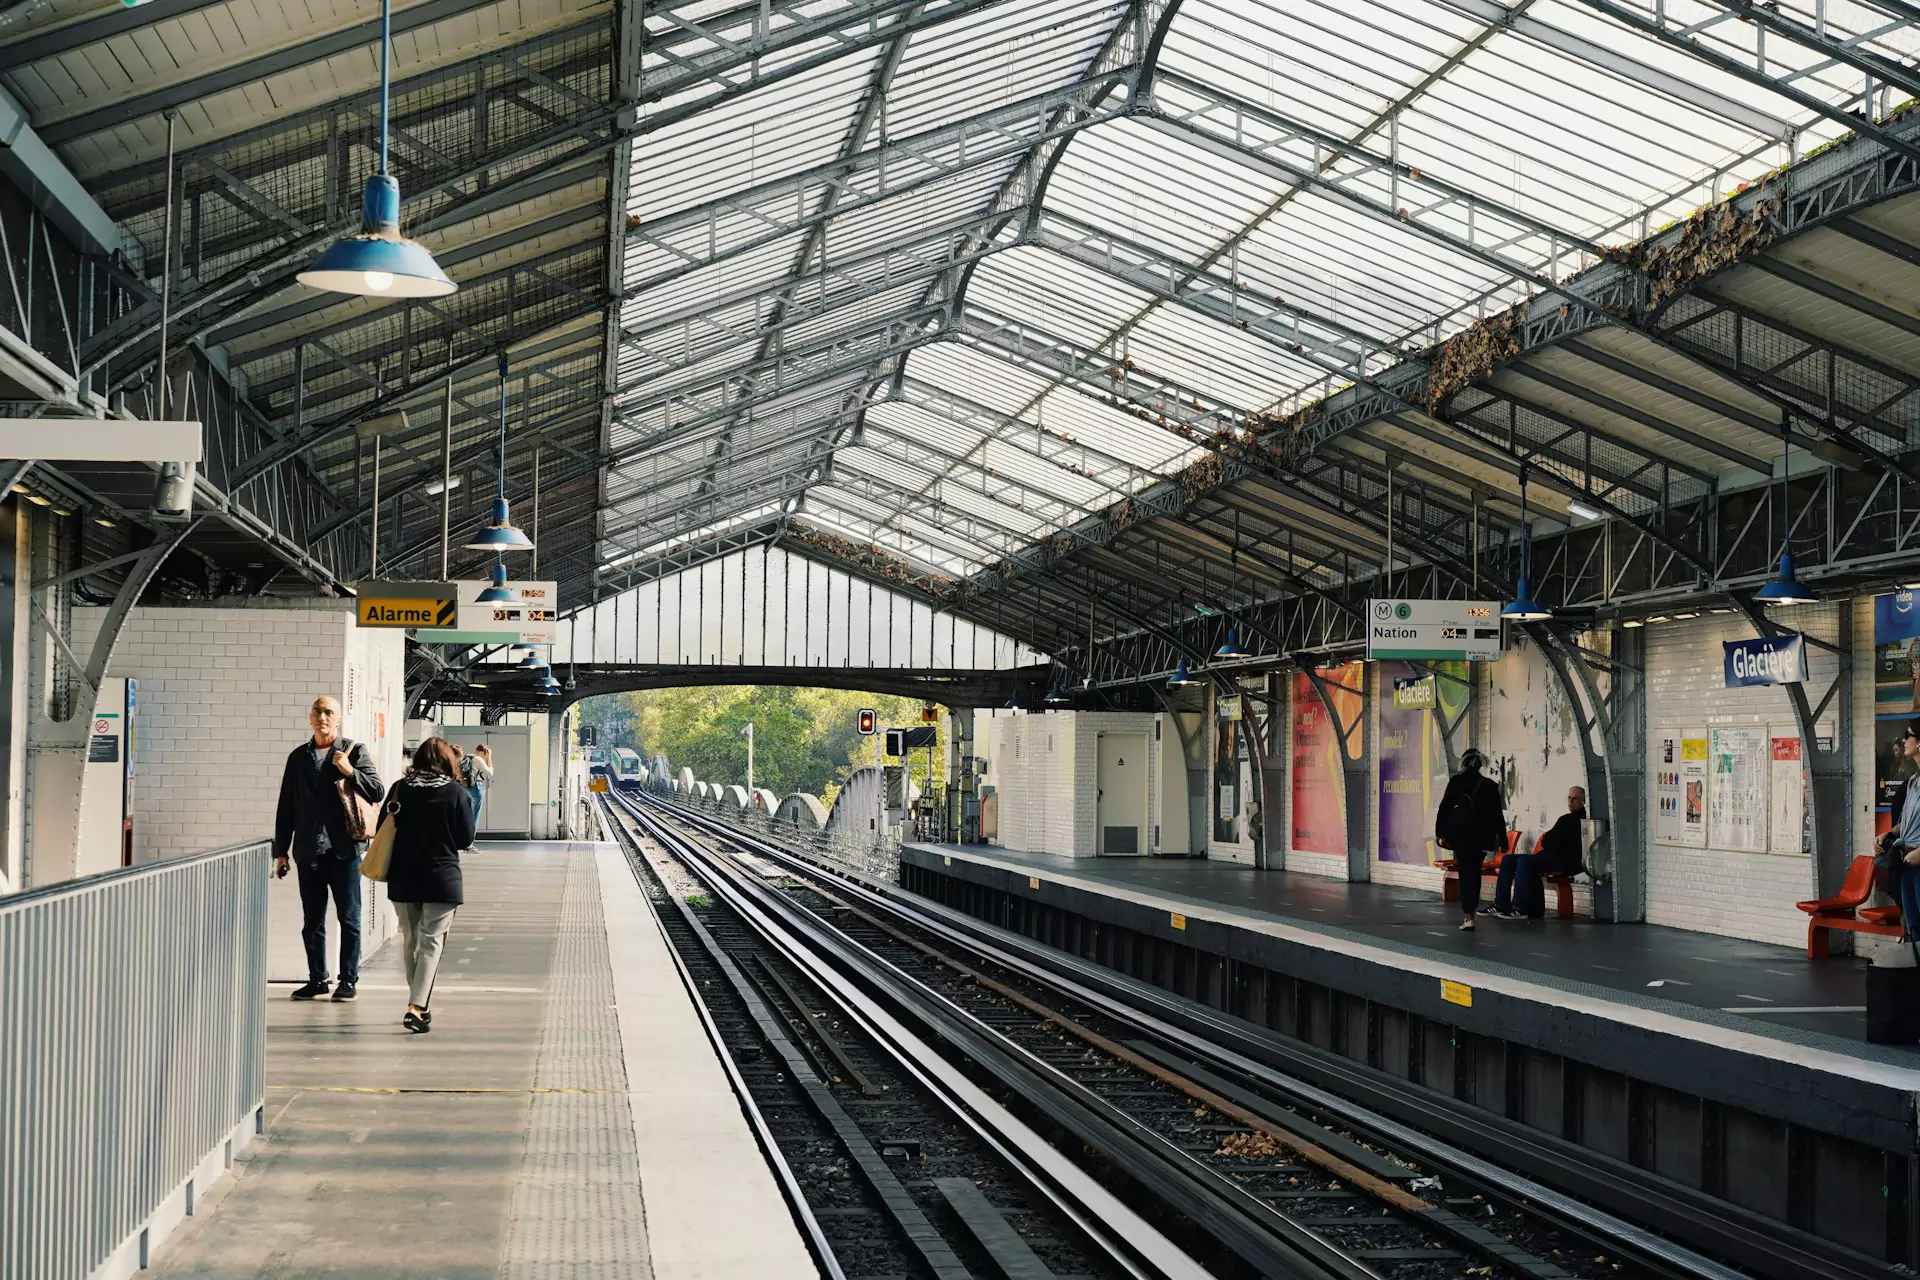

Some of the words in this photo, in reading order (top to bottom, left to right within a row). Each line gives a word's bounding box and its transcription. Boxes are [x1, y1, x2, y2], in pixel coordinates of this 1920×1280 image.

[367, 606, 431, 622] Alarme
[494, 610, 509, 621] 01
[528, 610, 544, 622] 04
[1399, 606, 1406, 616] 6
[1468, 608, 1490, 616] 13:56
[1374, 627, 1417, 638] Nation
[1441, 628, 1457, 638] 04
[1732, 643, 1793, 679] Glacière
[1398, 681, 1431, 704] Glacière
[920, 798, 934, 809] CM
